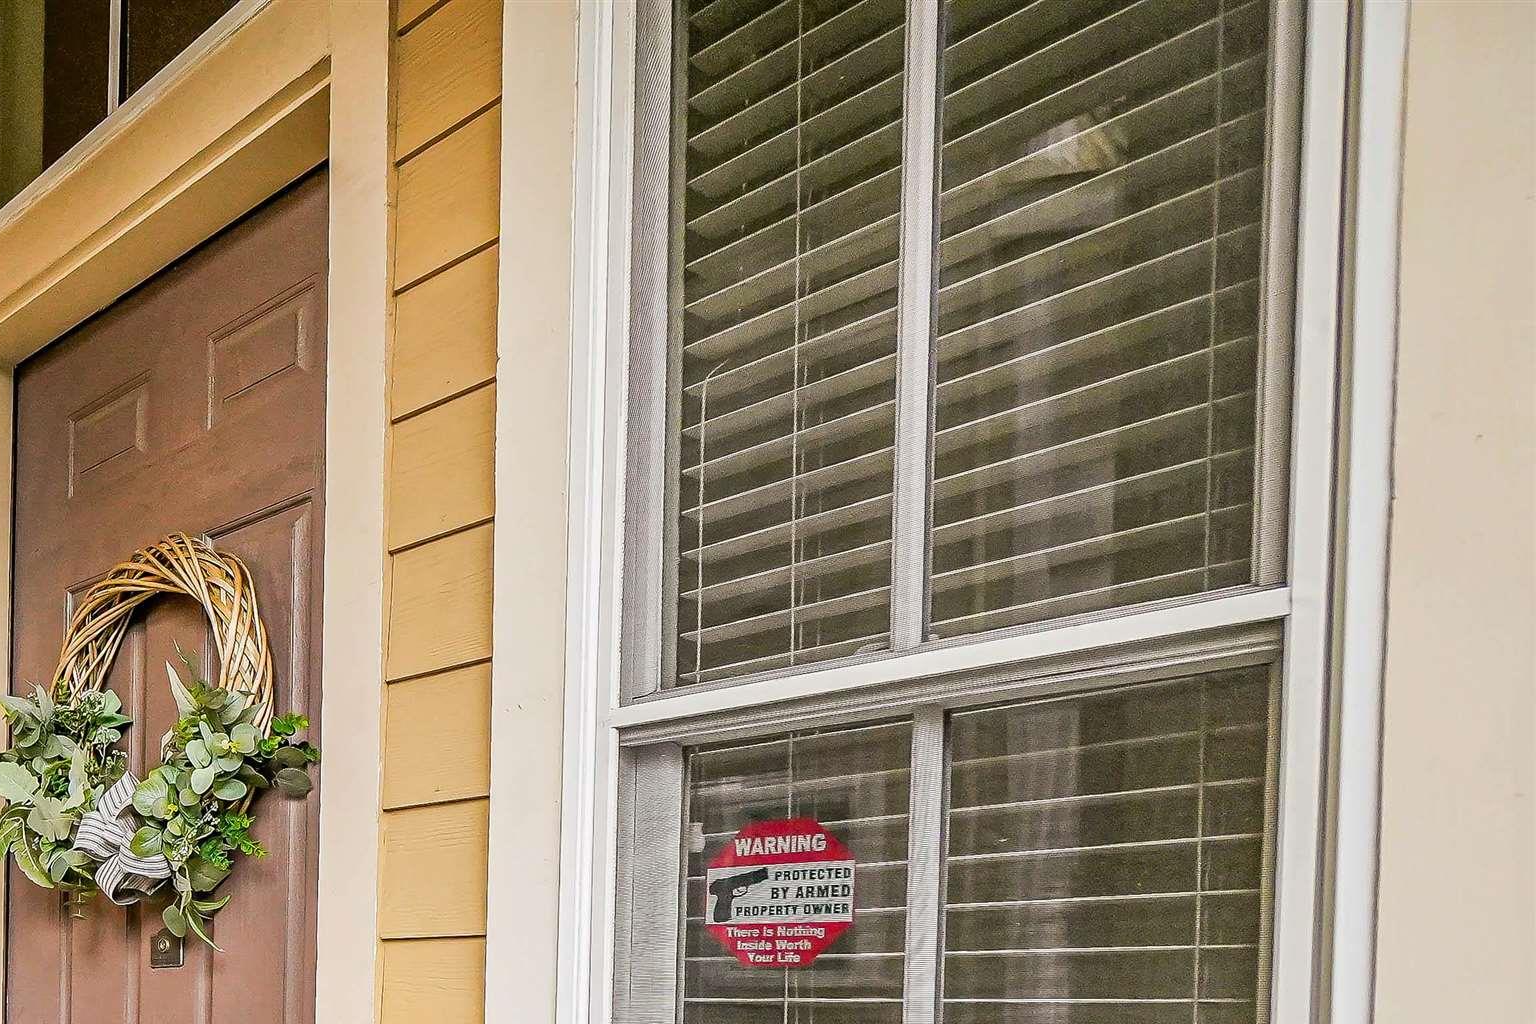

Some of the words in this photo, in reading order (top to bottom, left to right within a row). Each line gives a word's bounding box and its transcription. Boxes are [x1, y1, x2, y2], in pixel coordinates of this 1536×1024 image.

[735, 833, 827, 857] WARNING
[774, 867, 851, 881] PROTECTED
[771, 887, 789, 900] BY
[795, 884, 851, 899] ARMED
[735, 904, 799, 917] PROPERTY
[803, 903, 850, 915] OWNER
[727, 927, 760, 938] There
[777, 926, 826, 939] Nothing
[737, 940, 773, 950] Inside
[776, 939, 812, 950] Worth
[747, 952, 774, 963] Your
[777, 952, 801, 963] Life
